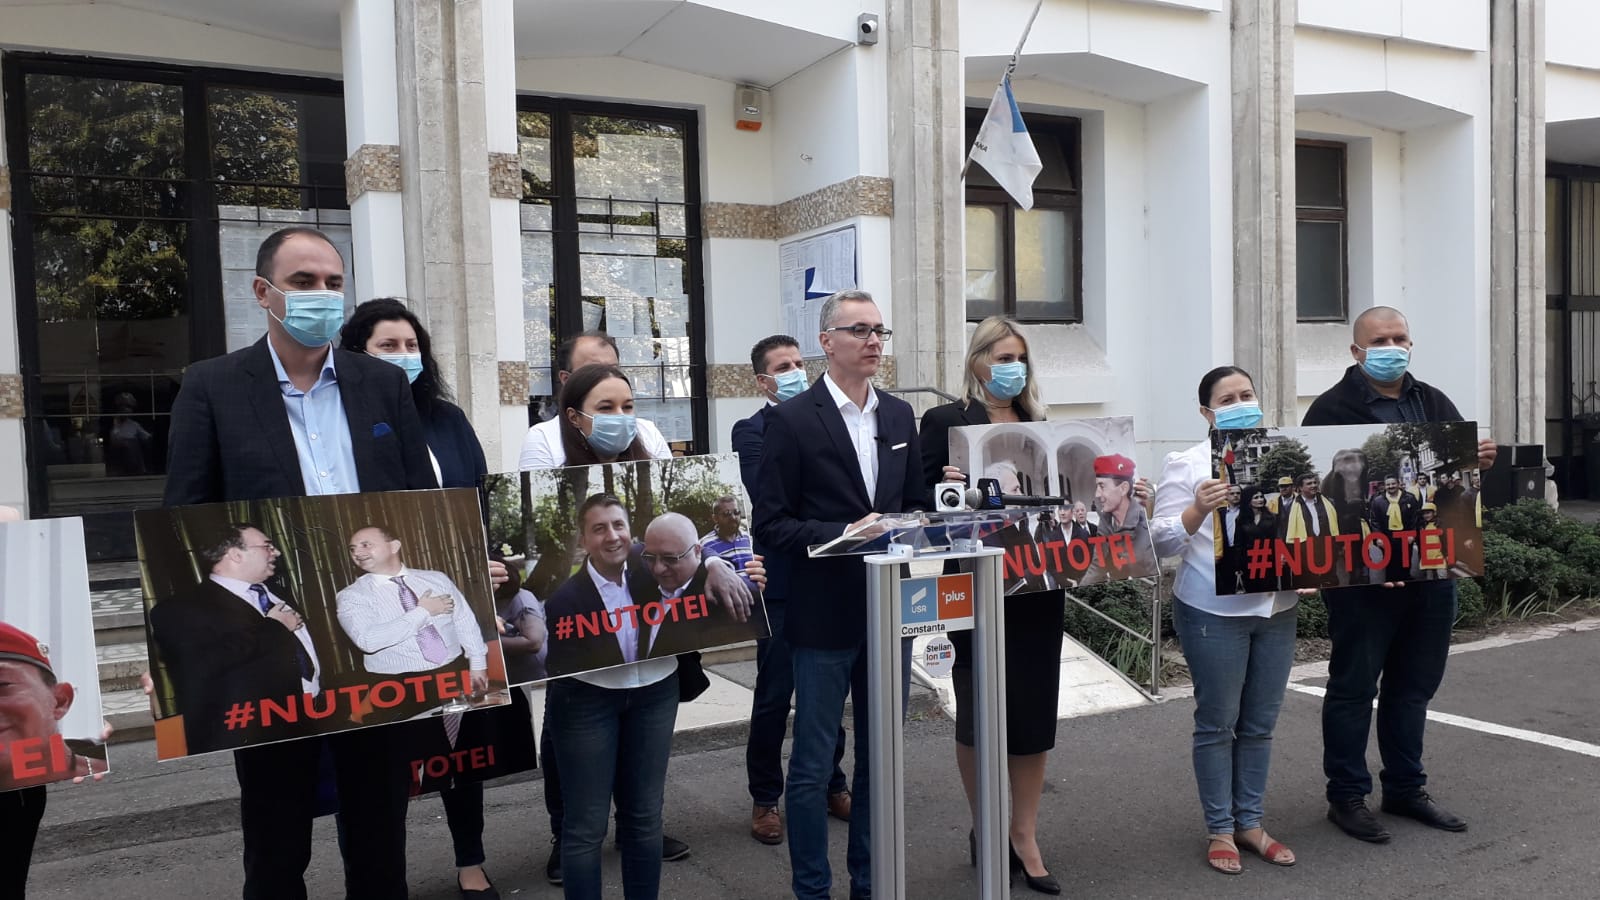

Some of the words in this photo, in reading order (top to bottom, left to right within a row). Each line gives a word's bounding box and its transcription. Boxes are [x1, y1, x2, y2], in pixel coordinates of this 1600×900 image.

[1247, 528, 1456, 579] #NUTOTEI
[555, 594, 708, 640] #NUTOTEI
[911, 605, 927, 614] USR
[926, 643, 952, 653] Stelian
[224, 670, 472, 730] #NUTOTEI
[0, 733, 67, 779] EI
